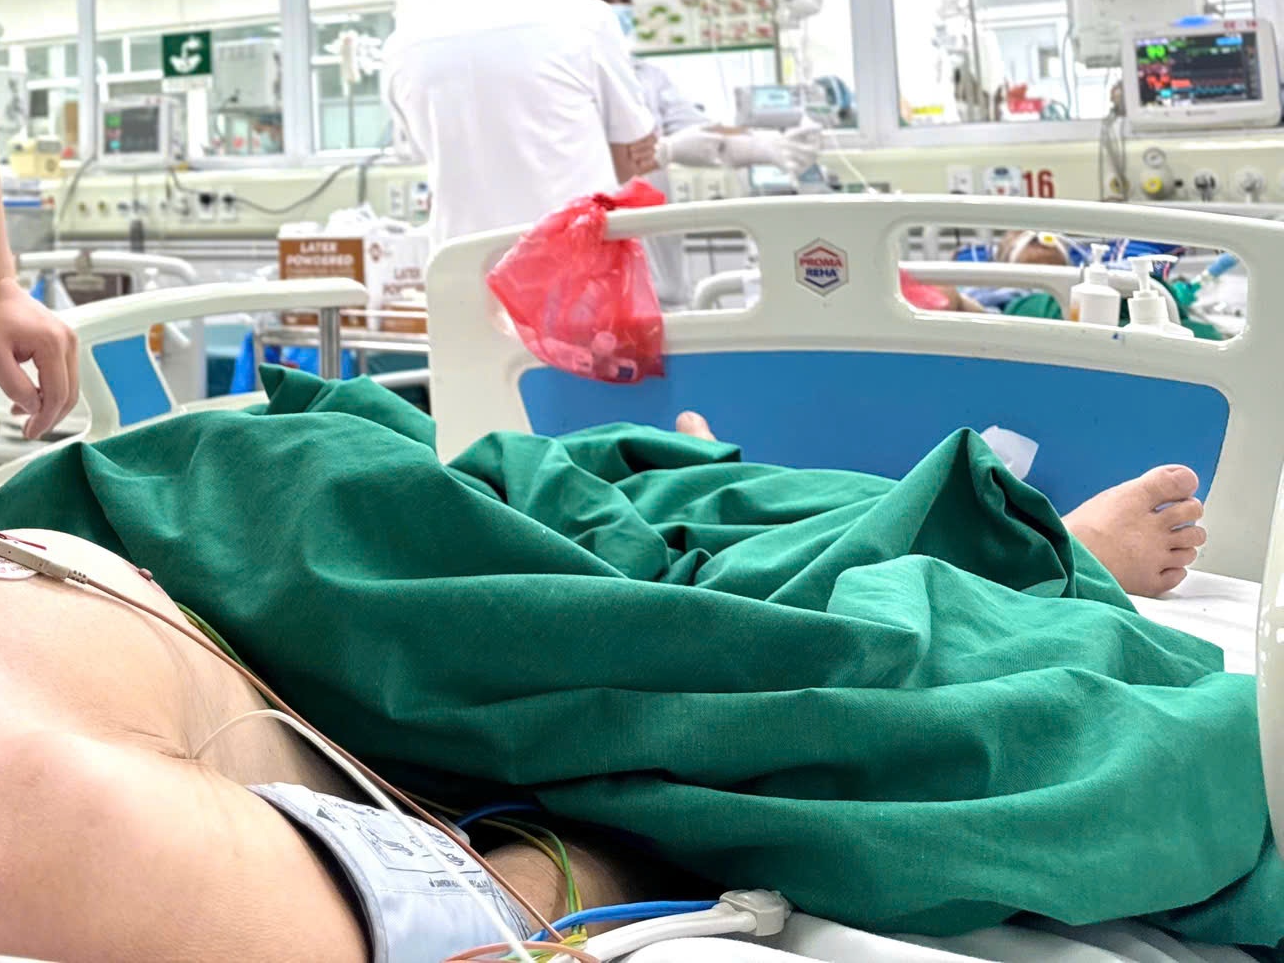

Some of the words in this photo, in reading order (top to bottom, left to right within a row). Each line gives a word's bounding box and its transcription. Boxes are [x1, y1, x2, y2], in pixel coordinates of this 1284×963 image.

[1021, 169, 1055, 198] 16
[799, 258, 843, 268] PROMA
[806, 268, 837, 277] REHA
